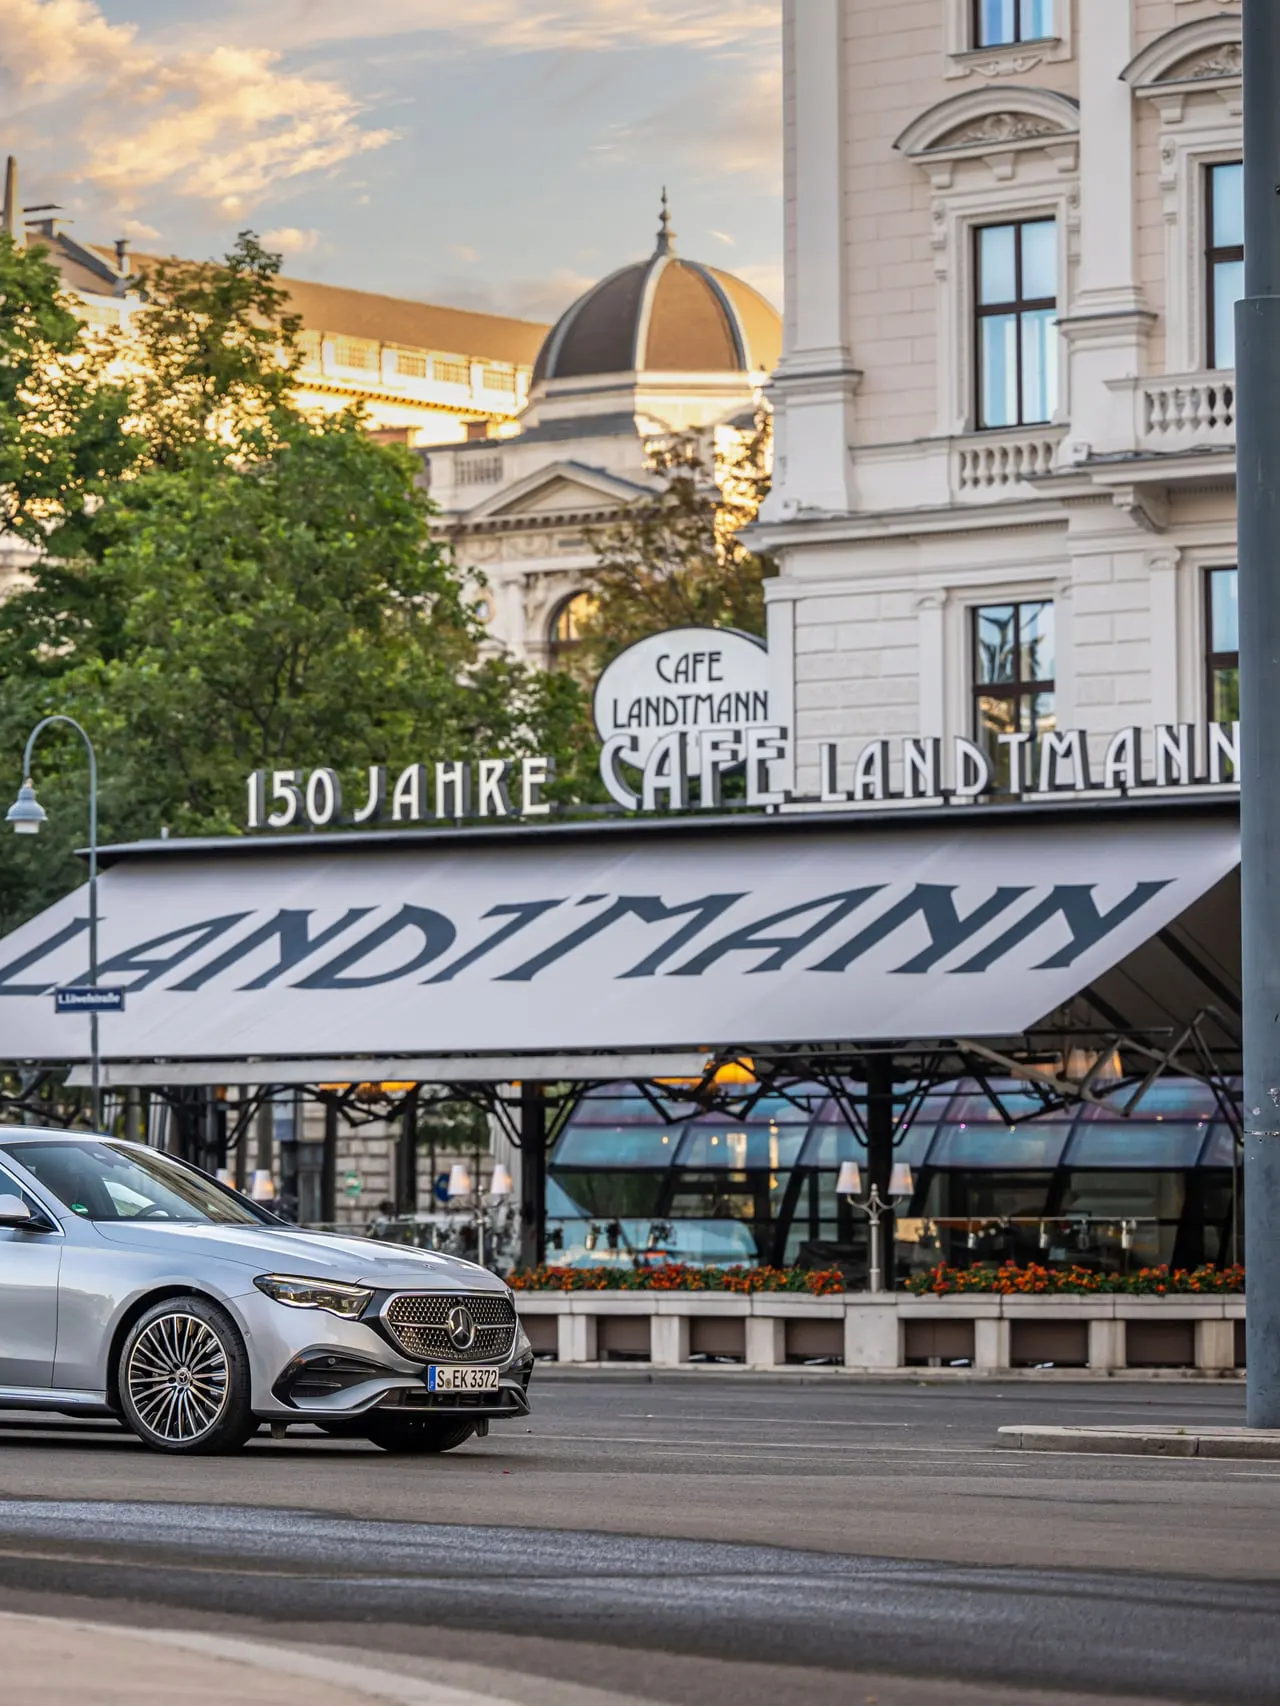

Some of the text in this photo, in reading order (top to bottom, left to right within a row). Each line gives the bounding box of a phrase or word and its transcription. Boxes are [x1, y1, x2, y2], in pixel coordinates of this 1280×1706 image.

[657, 652, 723, 683] CAFE
[612, 690, 769, 728] LANDTMANN
[246, 721, 1240, 828] 150 JAHRE CAFE LANDTMANN
[470, 1370, 497, 1388] 3372
